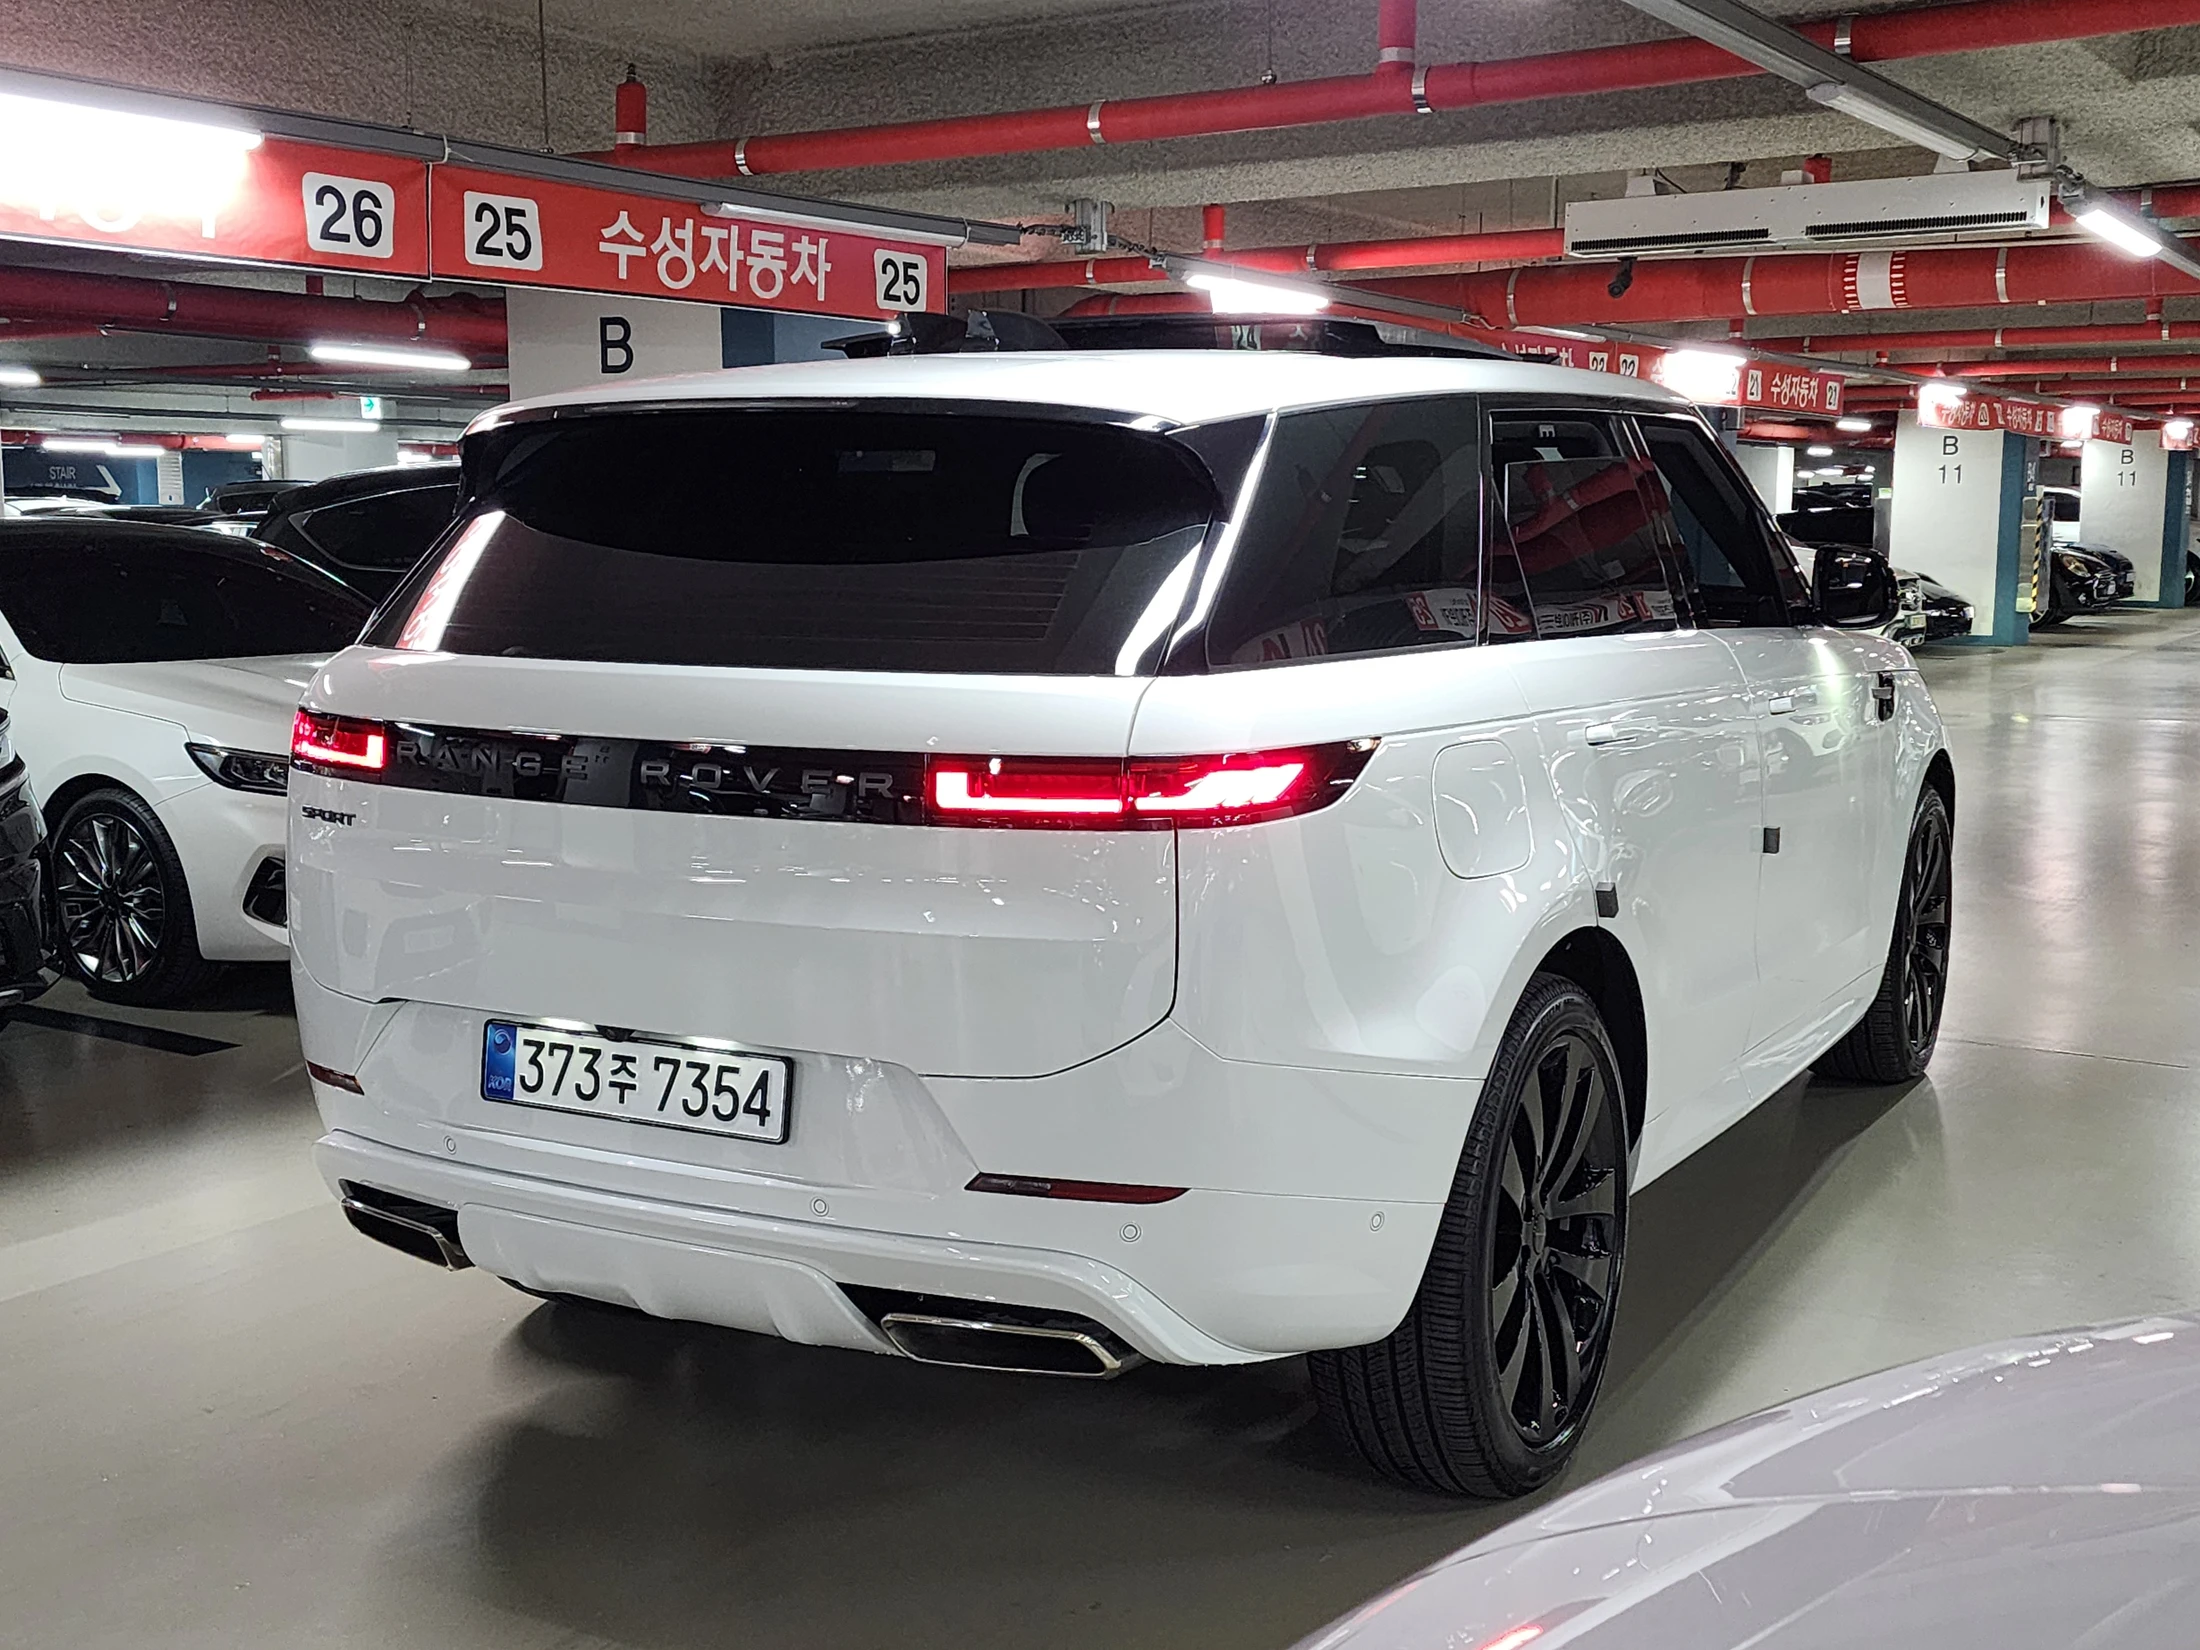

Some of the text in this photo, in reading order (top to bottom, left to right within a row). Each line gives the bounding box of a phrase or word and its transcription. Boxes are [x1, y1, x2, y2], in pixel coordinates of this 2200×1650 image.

[315, 185, 383, 248] 26
[474, 202, 921, 306] 25 수성자동차 25
[599, 316, 635, 374] B
[1749, 372, 1760, 397] 21
[1770, 372, 1820, 408] 수성자동차
[1827, 384, 1838, 407] 21
[1943, 435, 1959, 455] B
[2120, 449, 2134, 465] B
[50, 466, 76, 480] STAIR
[1938, 464, 1962, 484] 11
[2117, 471, 2137, 486] 11
[396, 740, 589, 781] RANGE
[639, 759, 895, 799] ROVER
[301, 805, 357, 827] SPORT
[488, 1074, 512, 1092] KOR
[519, 1038, 771, 1127] 373주 7354
